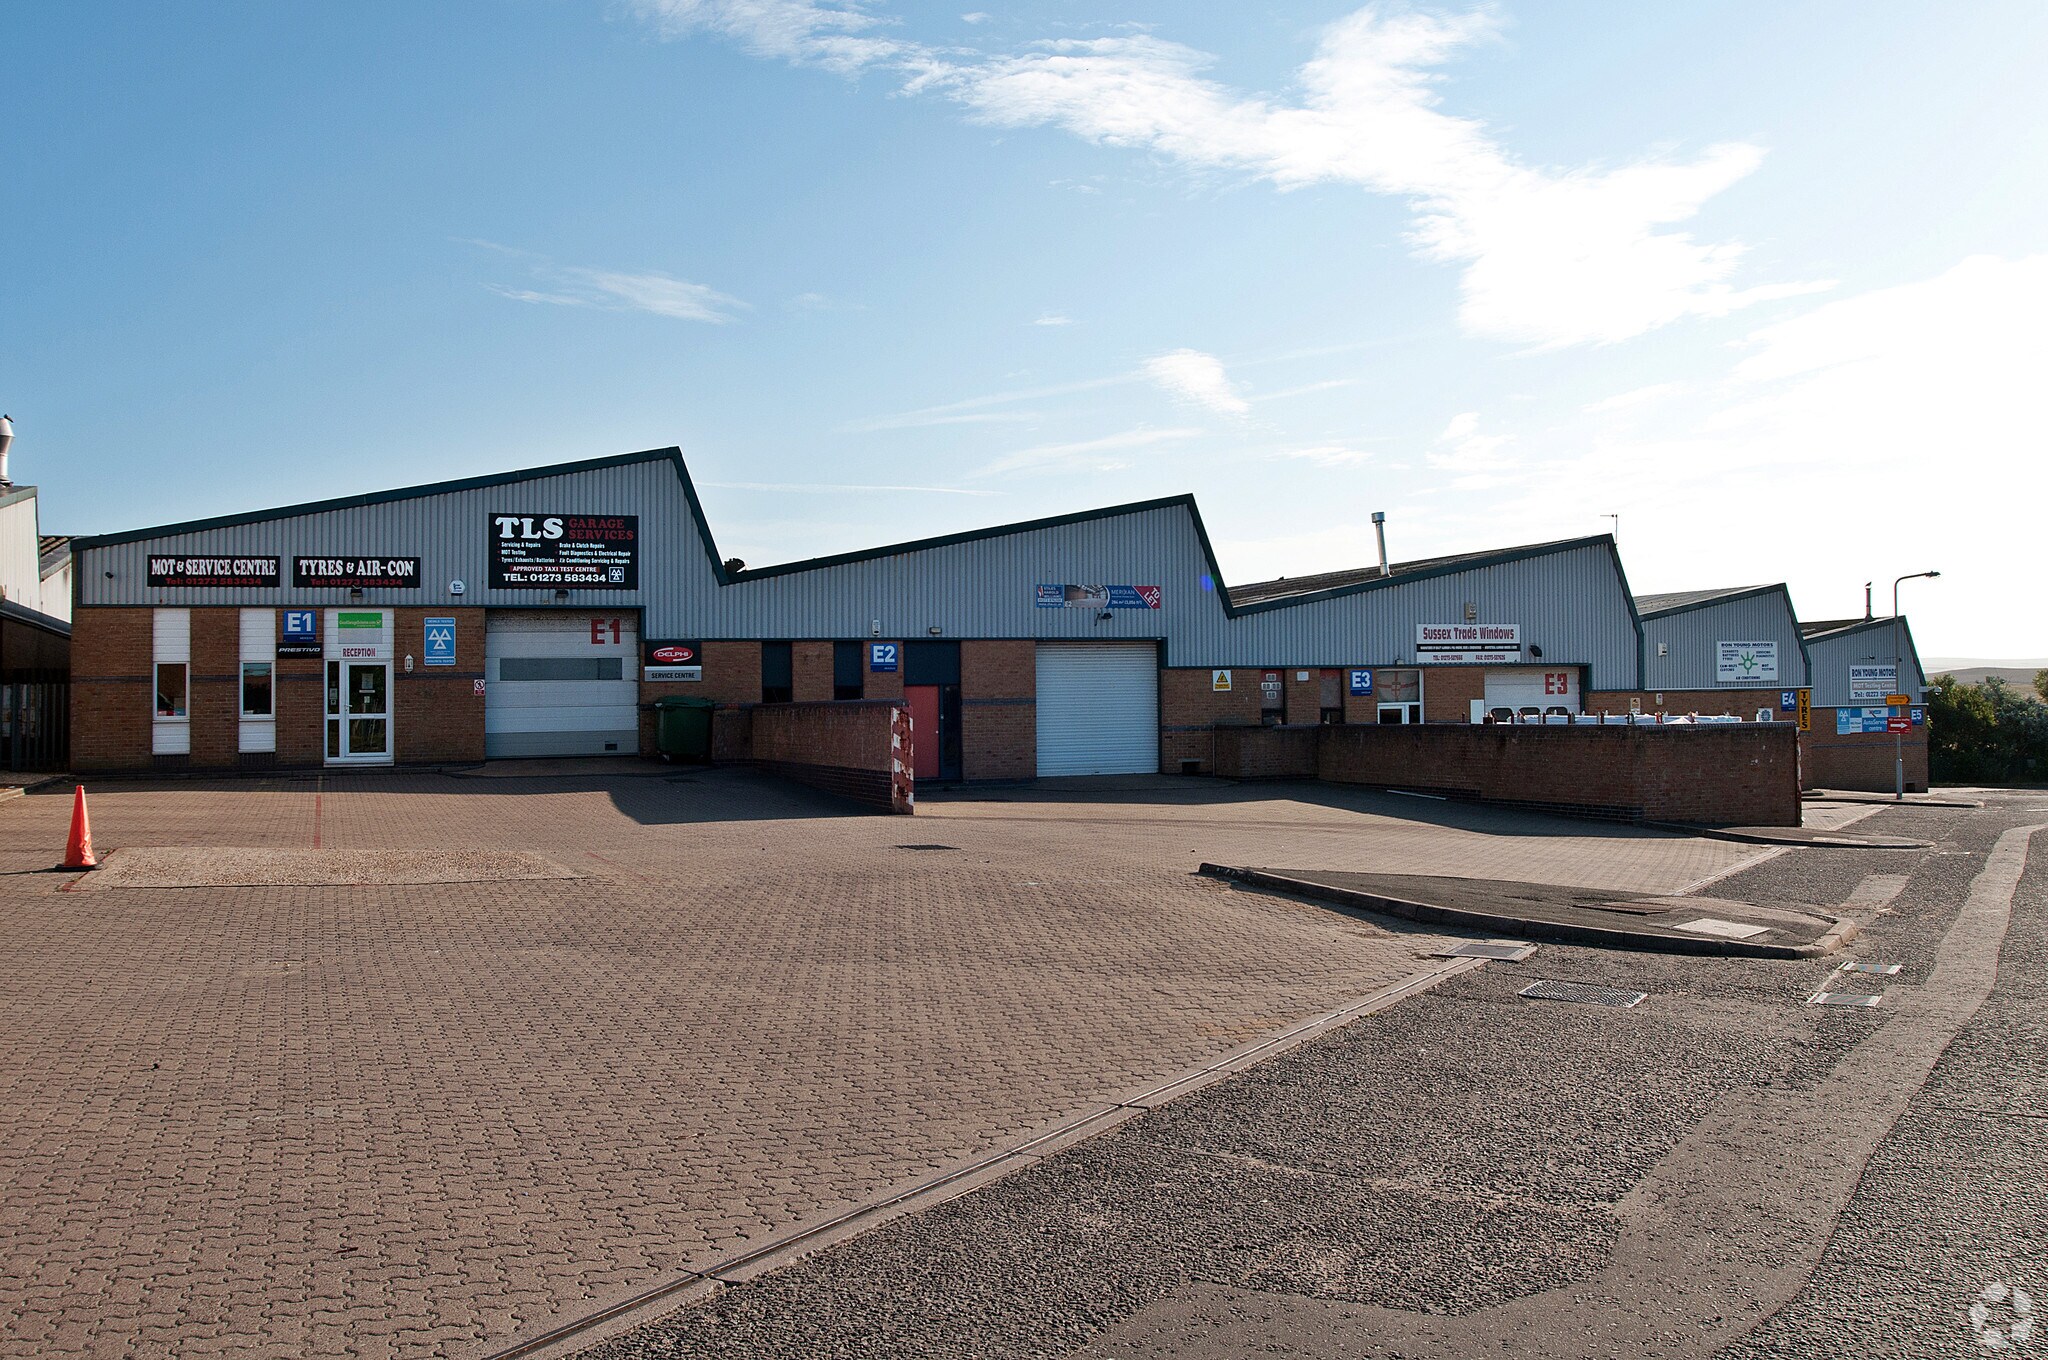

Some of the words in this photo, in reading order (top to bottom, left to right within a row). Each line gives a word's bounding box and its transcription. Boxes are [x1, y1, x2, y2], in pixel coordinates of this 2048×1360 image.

[495, 516, 564, 540] TLS
[568, 518, 625, 529] GARAGE
[568, 529, 634, 540] SERVICES
[511, 549, 526, 557] Testing
[151, 559, 175, 576] MOT
[177, 561, 184, 573] &
[185, 558, 232, 576] SERVICE
[233, 558, 277, 576] CENTRE
[299, 559, 344, 577] TYRES
[346, 561, 355, 573] &
[356, 559, 415, 577] AIR-CON
[165, 577, 184, 585] Tel:
[310, 578, 328, 586] Tel:
[329, 578, 361, 586] 01273
[362, 578, 403, 586] 583434
[503, 573, 528, 582] TEL:
[530, 573, 562, 583] 01273
[564, 573, 607, 583] 583434
[1144, 591, 1158, 606] LET
[1151, 587, 1160, 600] TO
[287, 613, 312, 632] E1
[591, 618, 620, 645] E1
[1423, 627, 1452, 640] Sussex
[1454, 626, 1477, 640] Trade
[1479, 626, 1514, 640] Windows
[342, 647, 376, 658] RECEPTION
[873, 645, 895, 663] E2
[1852, 669, 1862, 677] RON
[1862, 668, 1878, 677] YOUNG
[1352, 671, 1370, 688] E3
[1545, 673, 1568, 694] E3
[1865, 682, 1881, 690] Testing
[1782, 692, 1795, 705] E4
[1911, 709, 1922, 720] E5
